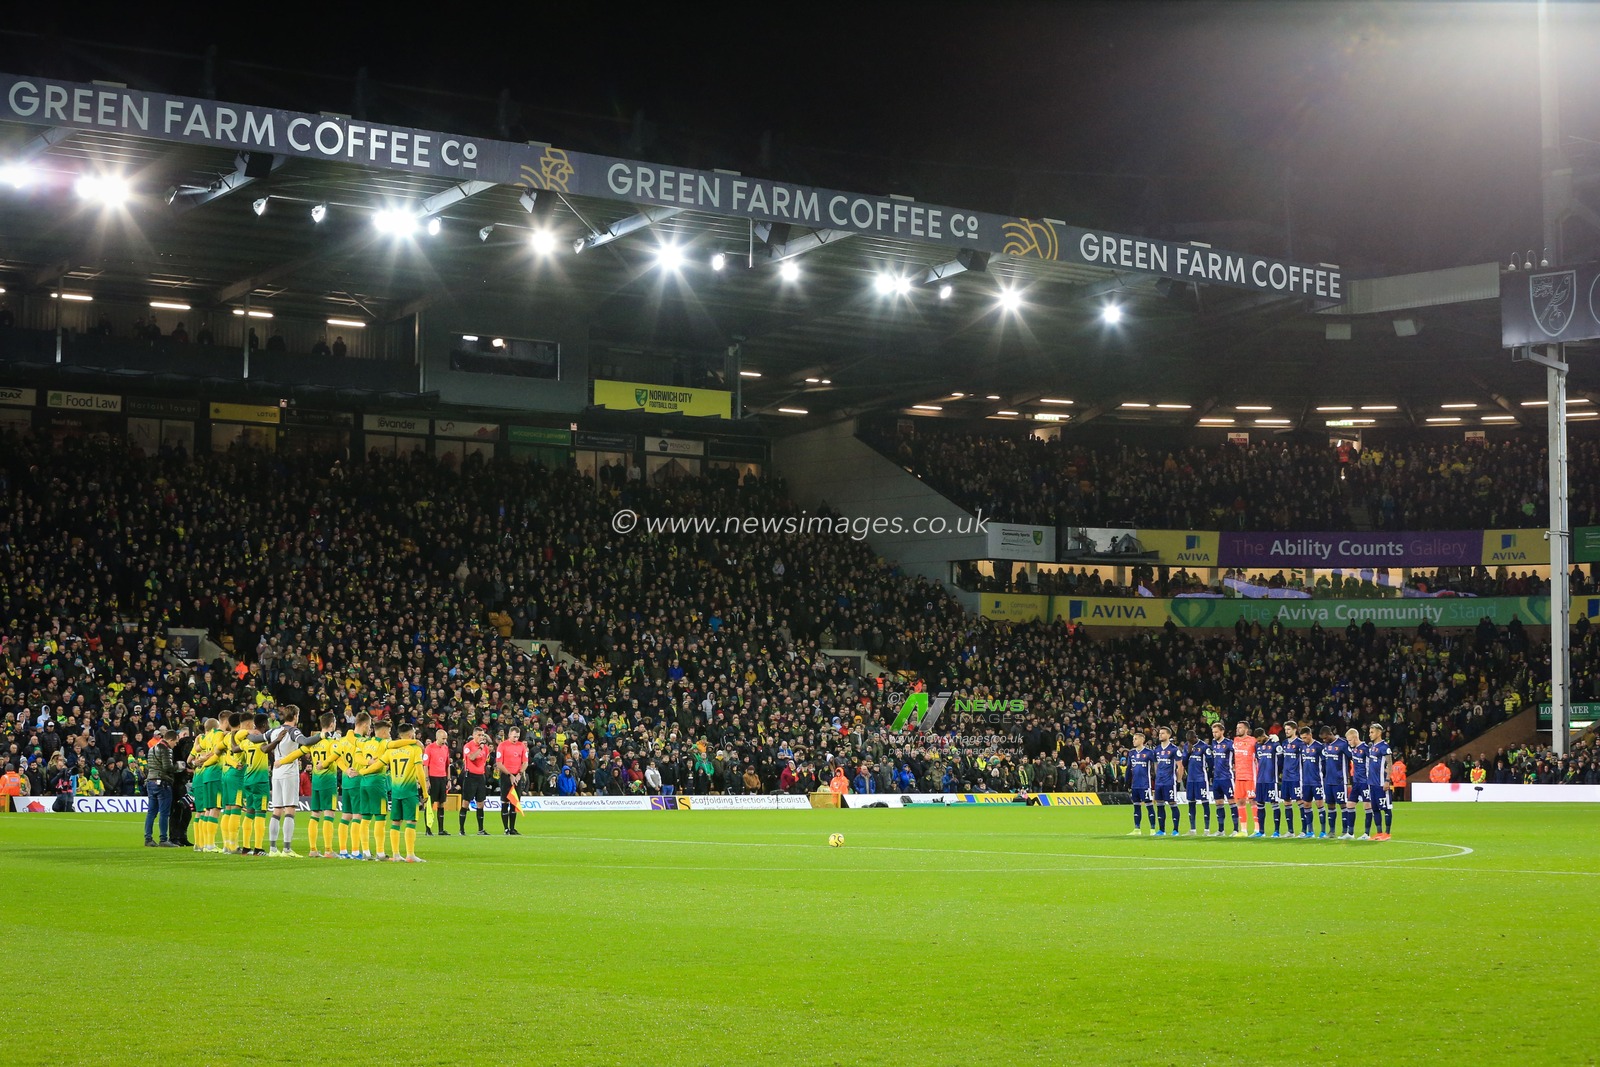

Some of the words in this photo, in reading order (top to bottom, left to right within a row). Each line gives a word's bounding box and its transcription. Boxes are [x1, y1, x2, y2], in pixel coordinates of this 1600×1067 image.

[8, 81, 150, 130] GREEN
[164, 100, 276, 147] FARM
[286, 118, 430, 168] COFFEE
[607, 162, 720, 208] GREEN
[732, 180, 820, 222] FARM
[829, 195, 942, 239] COFFEE
[1080, 232, 1168, 272] GREEN
[1177, 248, 1246, 284] FARM
[1252, 260, 1342, 299] COFFEE
[66, 395, 92, 408] Food
[96, 396, 118, 409] Law
[649, 390, 678, 402] NORWICH
[678, 392, 692, 403] CITY
[1176, 552, 1210, 561] AVIVA
[1232, 540, 1264, 556] The
[1270, 540, 1332, 559] Ability
[1338, 540, 1404, 556] Counts
[1410, 540, 1466, 559] Gallery
[1492, 552, 1526, 561] AVIVA
[1092, 604, 1146, 619] AVIVA
[1240, 604, 1270, 618] The
[1277, 604, 1329, 620] Aviva
[1335, 604, 1443, 624] Community
[1450, 602, 1497, 618] Stand
[393, 758, 409, 778] 17
[690, 796, 733, 805] Scaffolding
[1057, 796, 1094, 805] AVIVA
